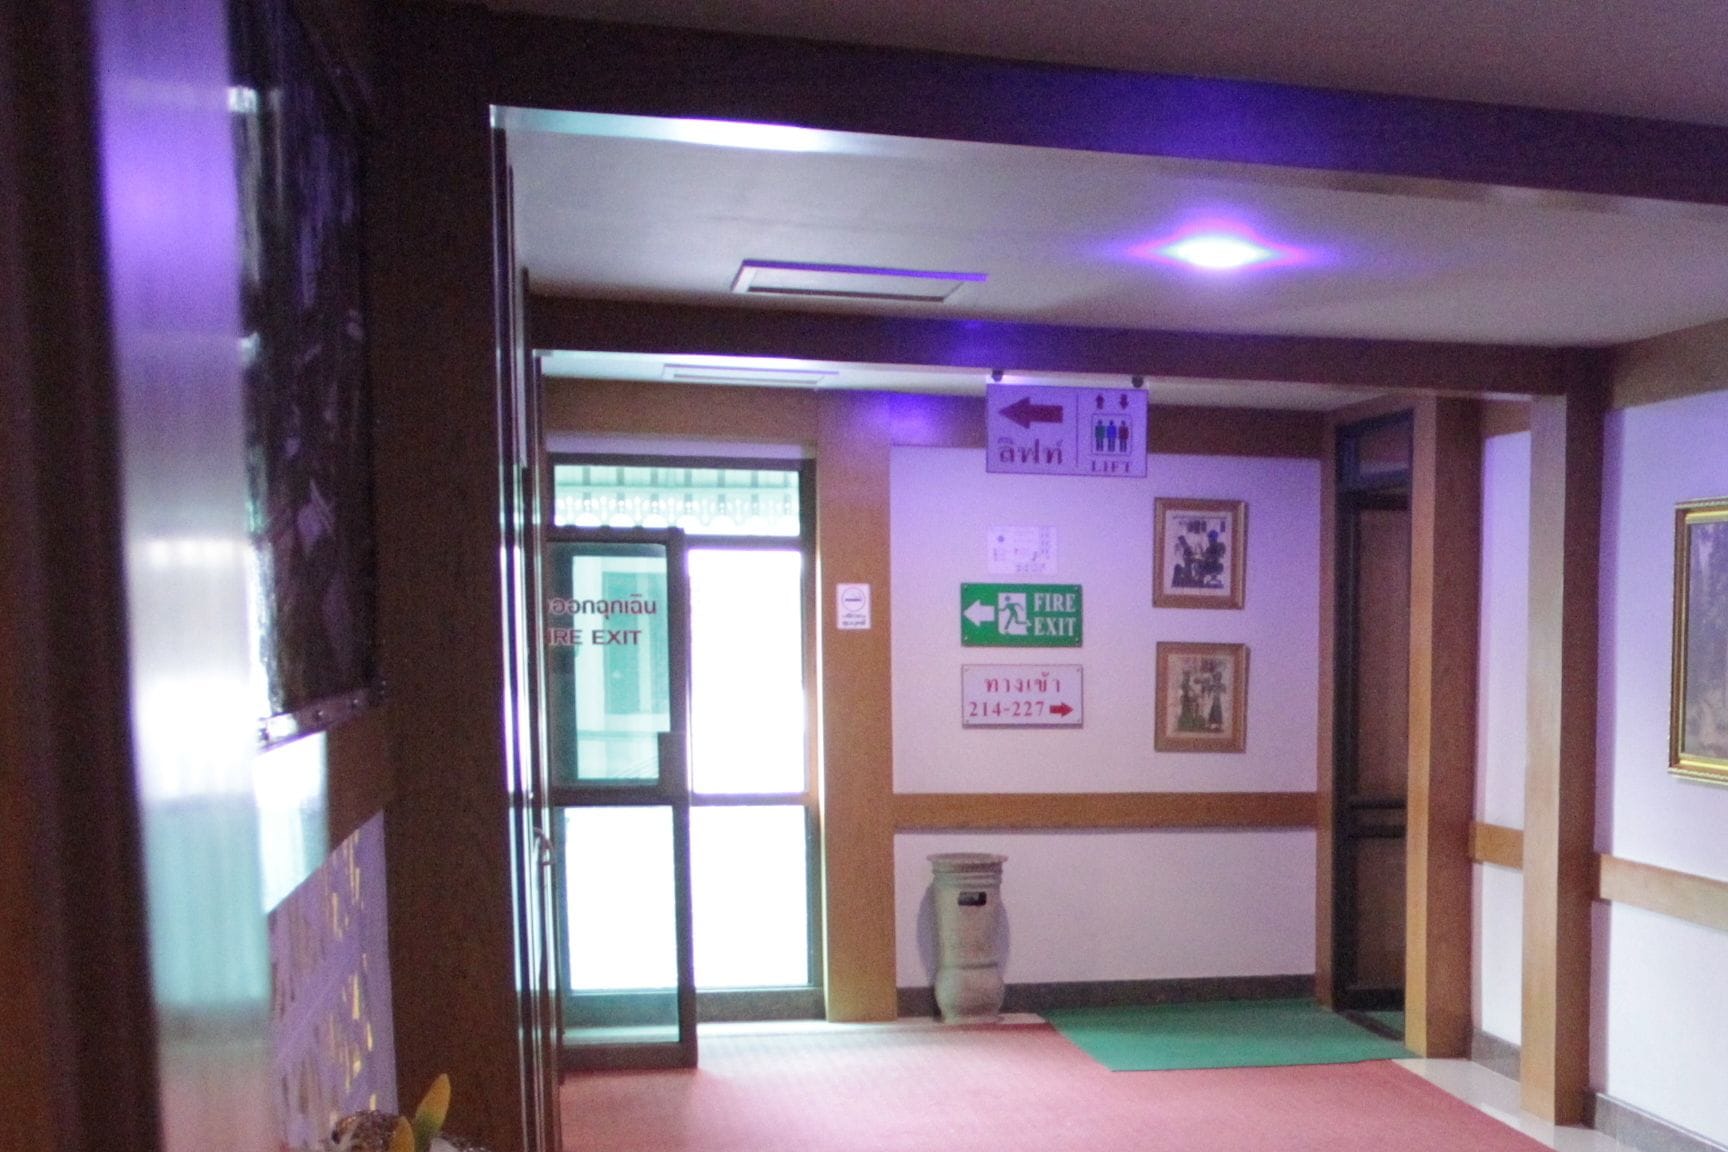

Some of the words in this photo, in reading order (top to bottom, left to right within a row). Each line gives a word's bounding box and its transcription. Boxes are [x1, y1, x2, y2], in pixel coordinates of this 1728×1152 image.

[1090, 460, 1134, 473] LIFT
[549, 593, 657, 620] ออกฉุกเฉิน
[1033, 593, 1076, 612] FIRE
[1034, 617, 1076, 636] EXIT
[549, 629, 583, 645] IRE
[591, 629, 643, 645] EXIT
[984, 671, 1061, 693] ทางเข้า
[968, 700, 1045, 718] 214-227
